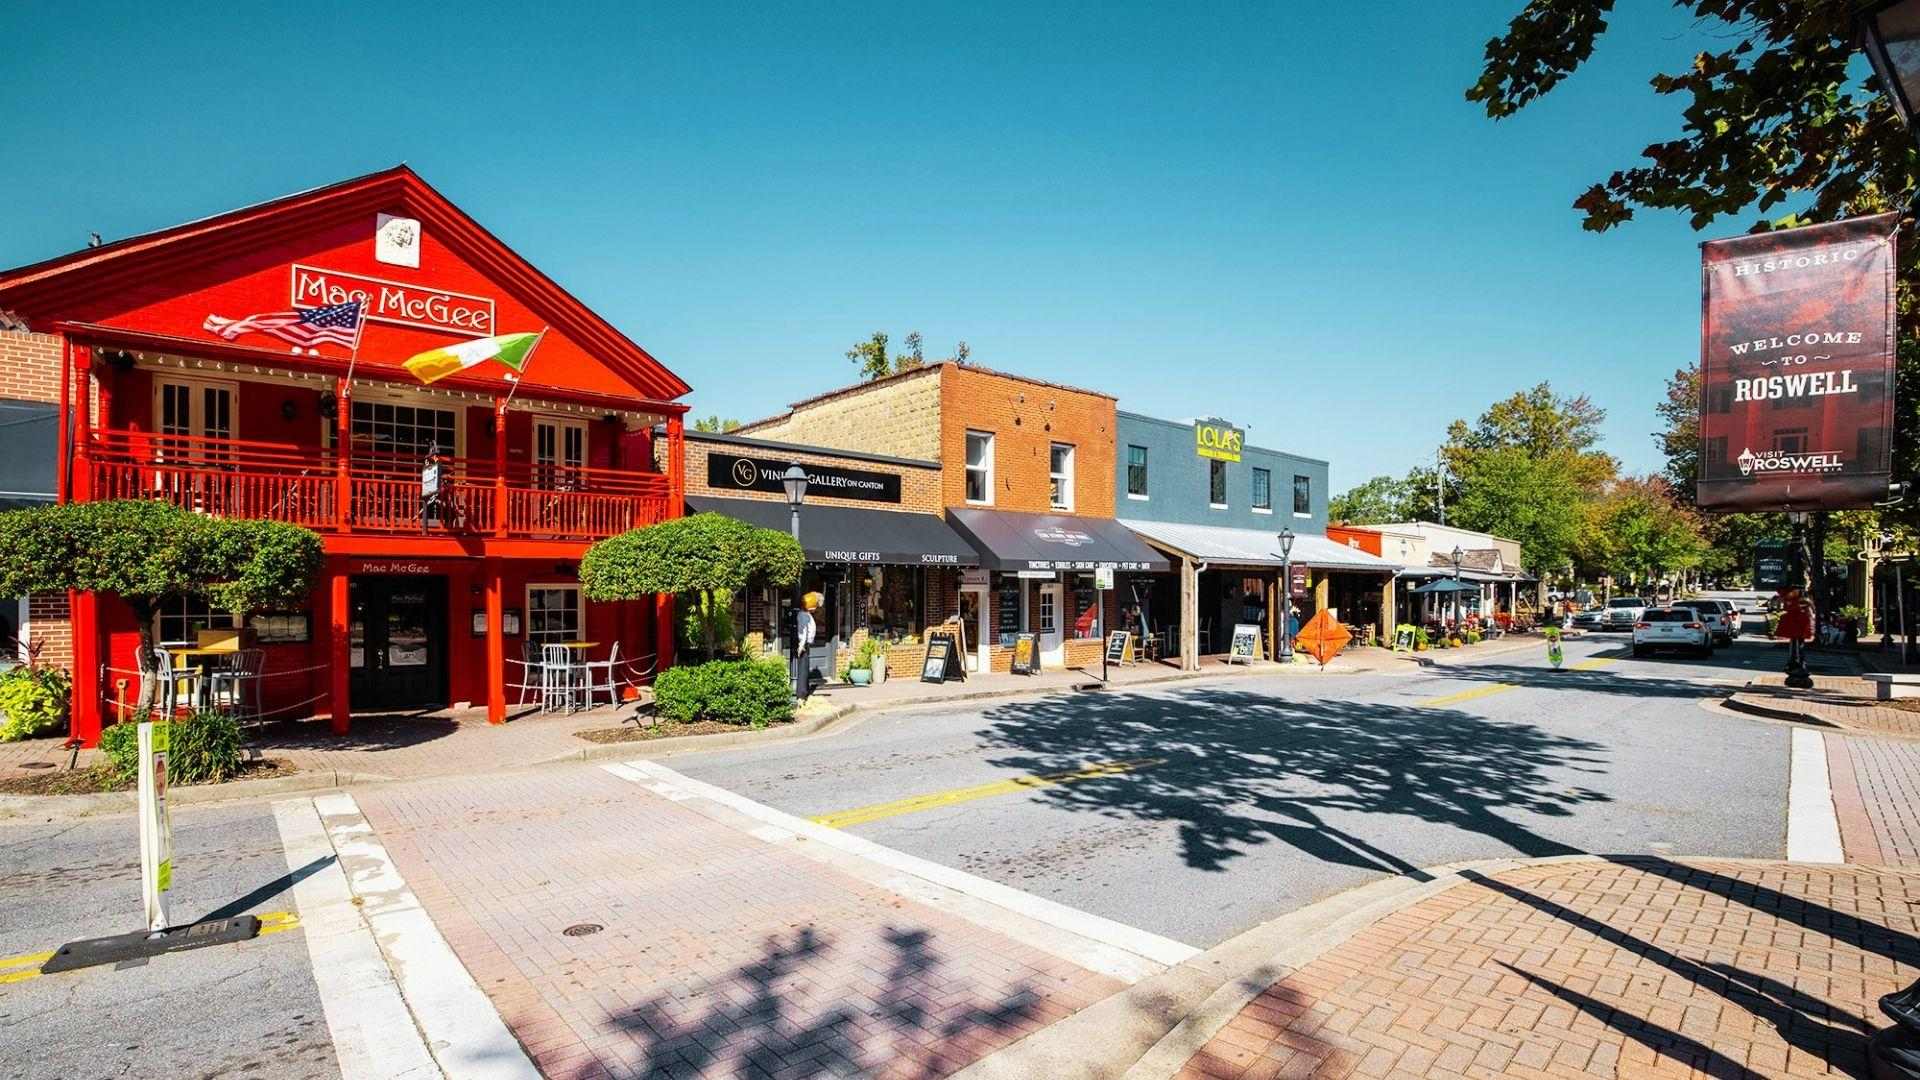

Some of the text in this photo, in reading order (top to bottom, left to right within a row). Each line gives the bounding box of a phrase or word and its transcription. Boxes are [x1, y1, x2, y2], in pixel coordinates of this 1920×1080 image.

[1735, 250, 1857, 277] HISTORIC
[378, 287, 490, 329] McGee
[1730, 332, 1863, 355] WELCOME
[1781, 354, 1807, 366] TO
[1734, 369, 1858, 402] ROSWELL
[1753, 454, 1843, 471] ROSWELL
[1755, 450, 1785, 459] VISIT
[808, 473, 848, 488] GALLERY
[858, 480, 884, 490] CANTON
[825, 551, 880, 561] UNIQUE GIFTS
[921, 554, 958, 563] SCULPTURE
[362, 562, 431, 574] Mac McGee
